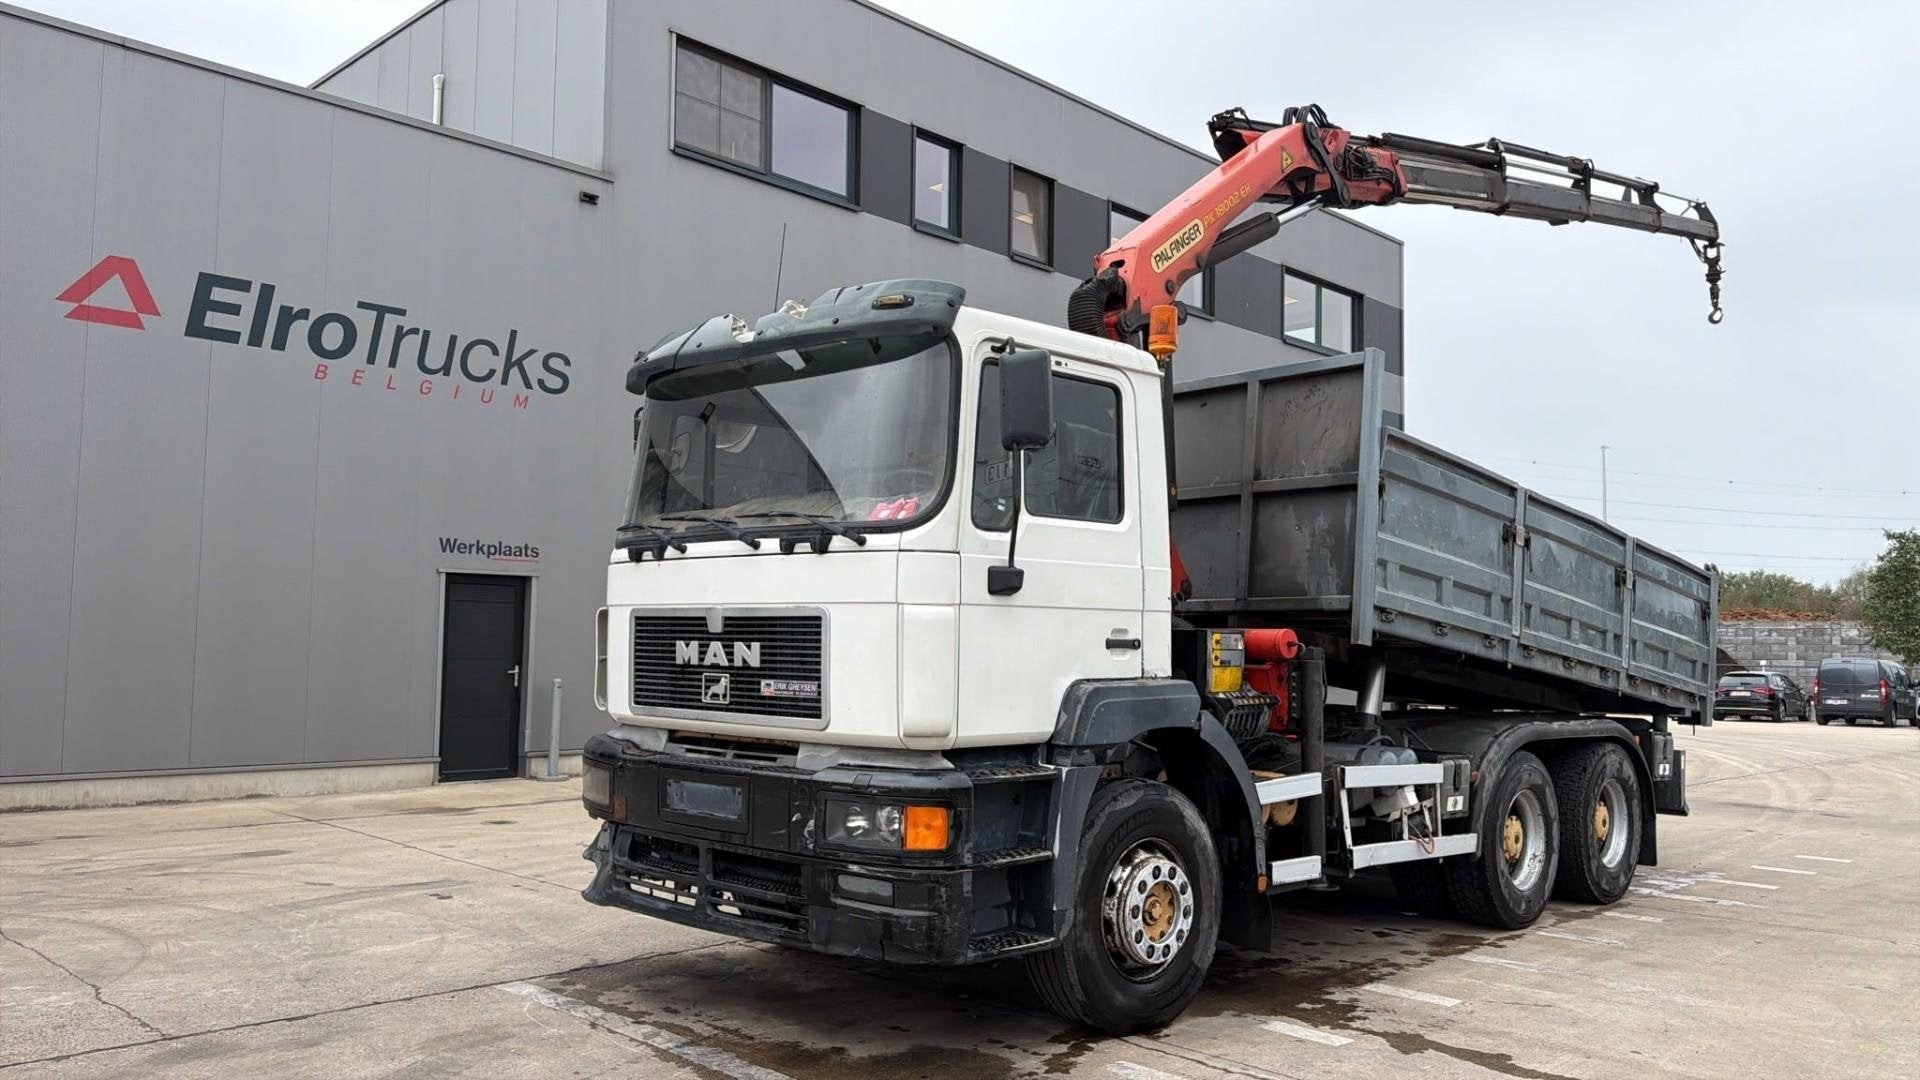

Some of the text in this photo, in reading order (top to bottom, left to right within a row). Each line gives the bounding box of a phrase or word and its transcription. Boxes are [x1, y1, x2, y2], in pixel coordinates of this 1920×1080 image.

[1203, 211, 1216, 228] PK
[1154, 223, 1202, 270] PALFINGER
[184, 271, 572, 395] ElroTrucks
[314, 363, 529, 409] BELGIUM
[439, 537, 540, 559] Werkplaats
[675, 640, 761, 668] MAN
